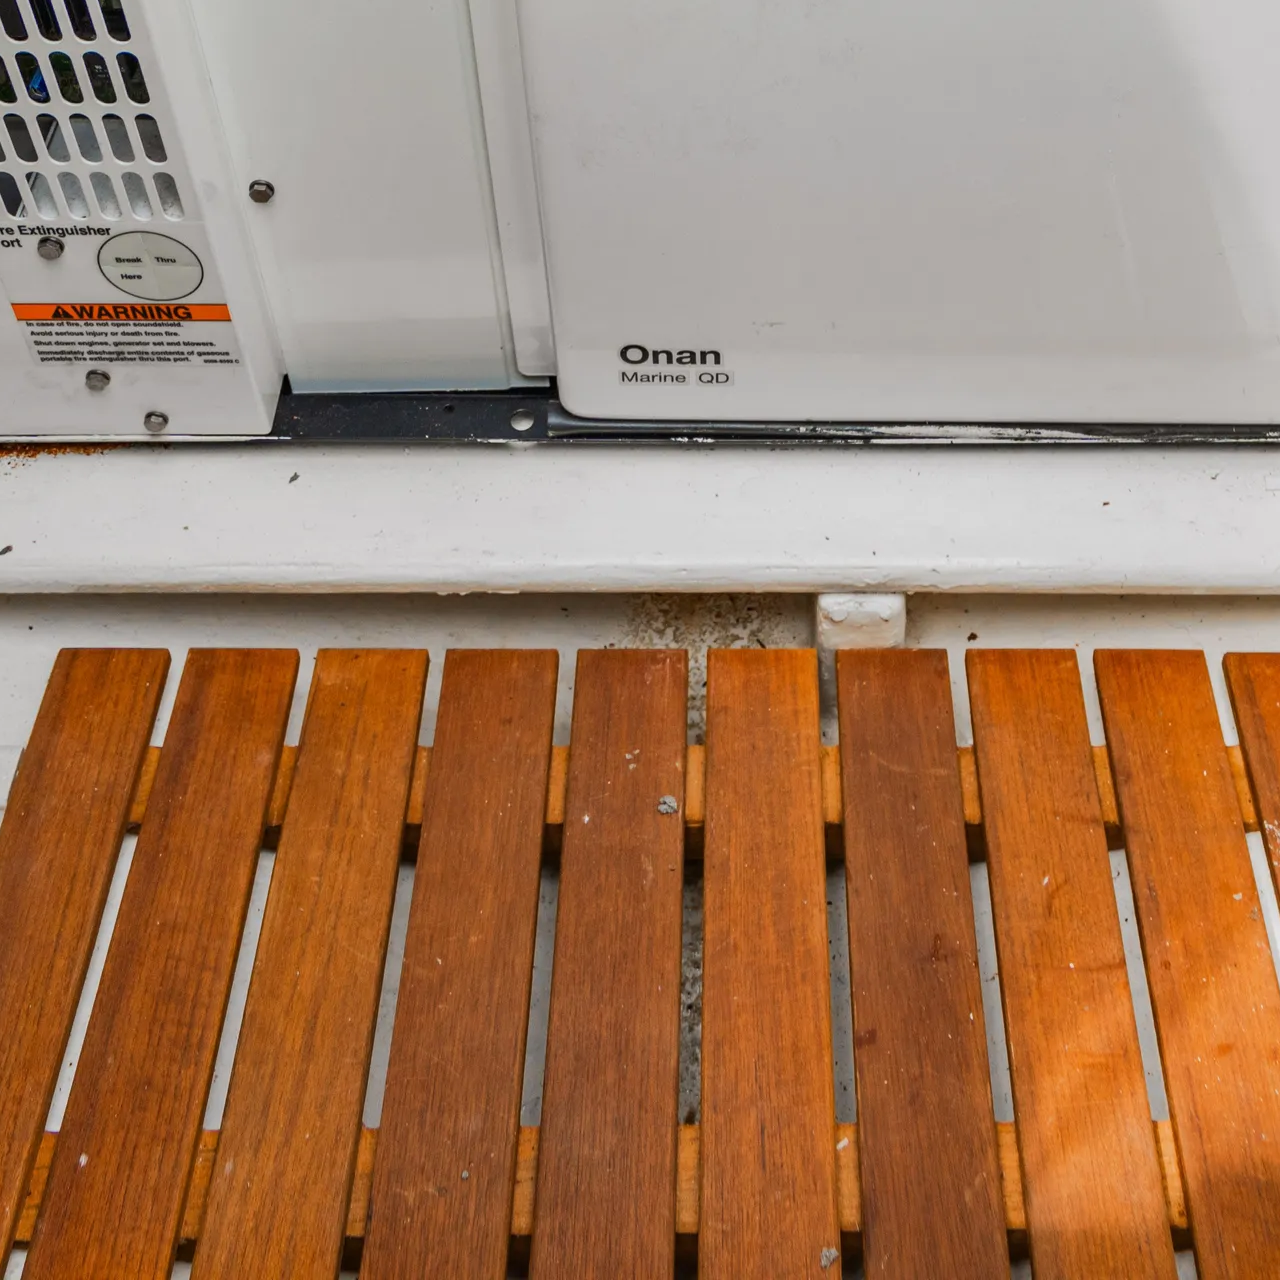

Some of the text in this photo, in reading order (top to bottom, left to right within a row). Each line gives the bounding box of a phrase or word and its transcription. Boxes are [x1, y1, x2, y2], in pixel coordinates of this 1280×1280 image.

[18, 225, 111, 237] Extinguisher
[72, 305, 192, 319] WARNING
[620, 344, 721, 364] Onan
[622, 372, 729, 384] Marine QD
